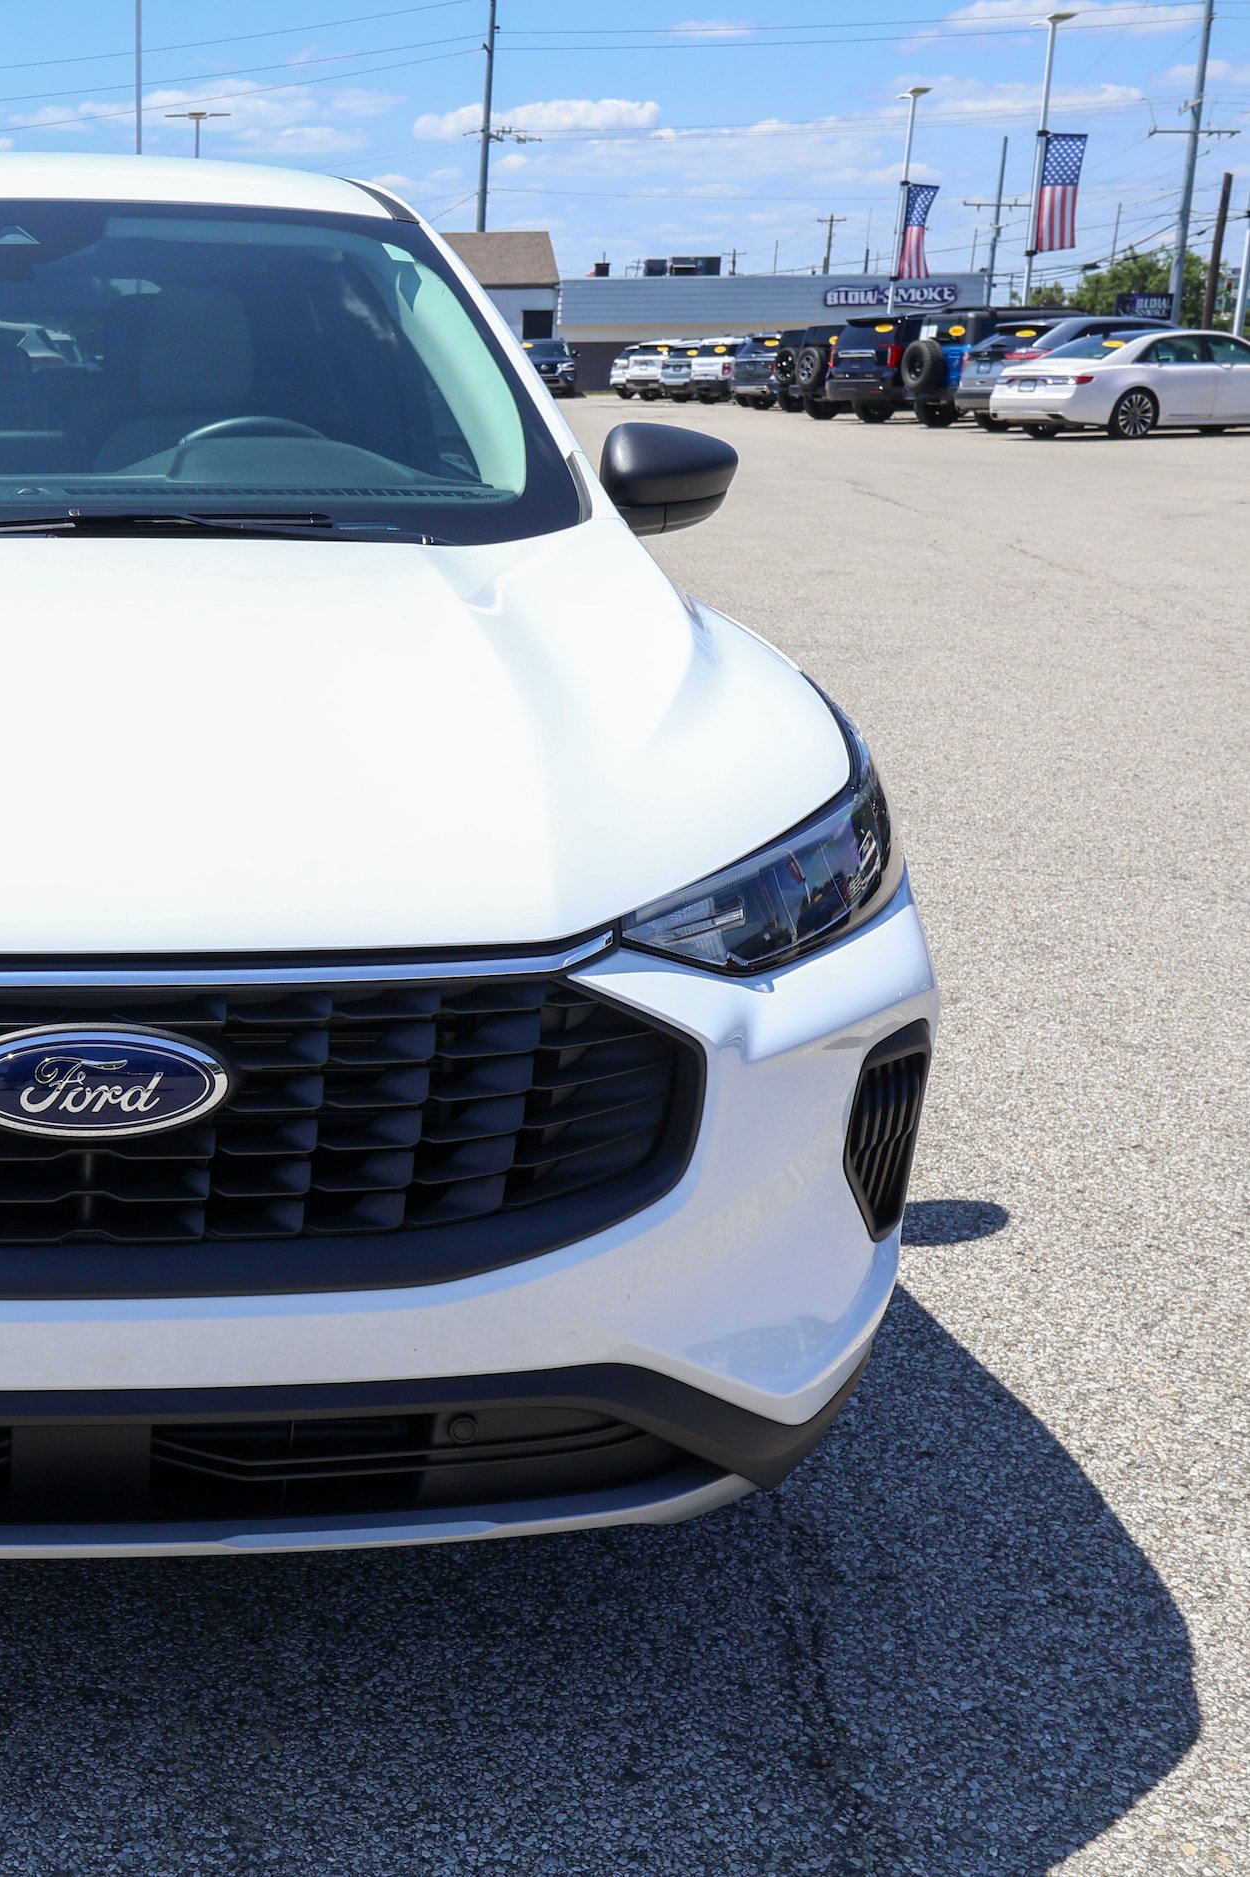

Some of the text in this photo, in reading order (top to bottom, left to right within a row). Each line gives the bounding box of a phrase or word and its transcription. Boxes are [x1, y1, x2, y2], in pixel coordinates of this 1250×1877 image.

[826, 289, 877, 305] BLOW
[1136, 298, 1170, 309] BLOW
[20, 1056, 163, 1113] Ford
